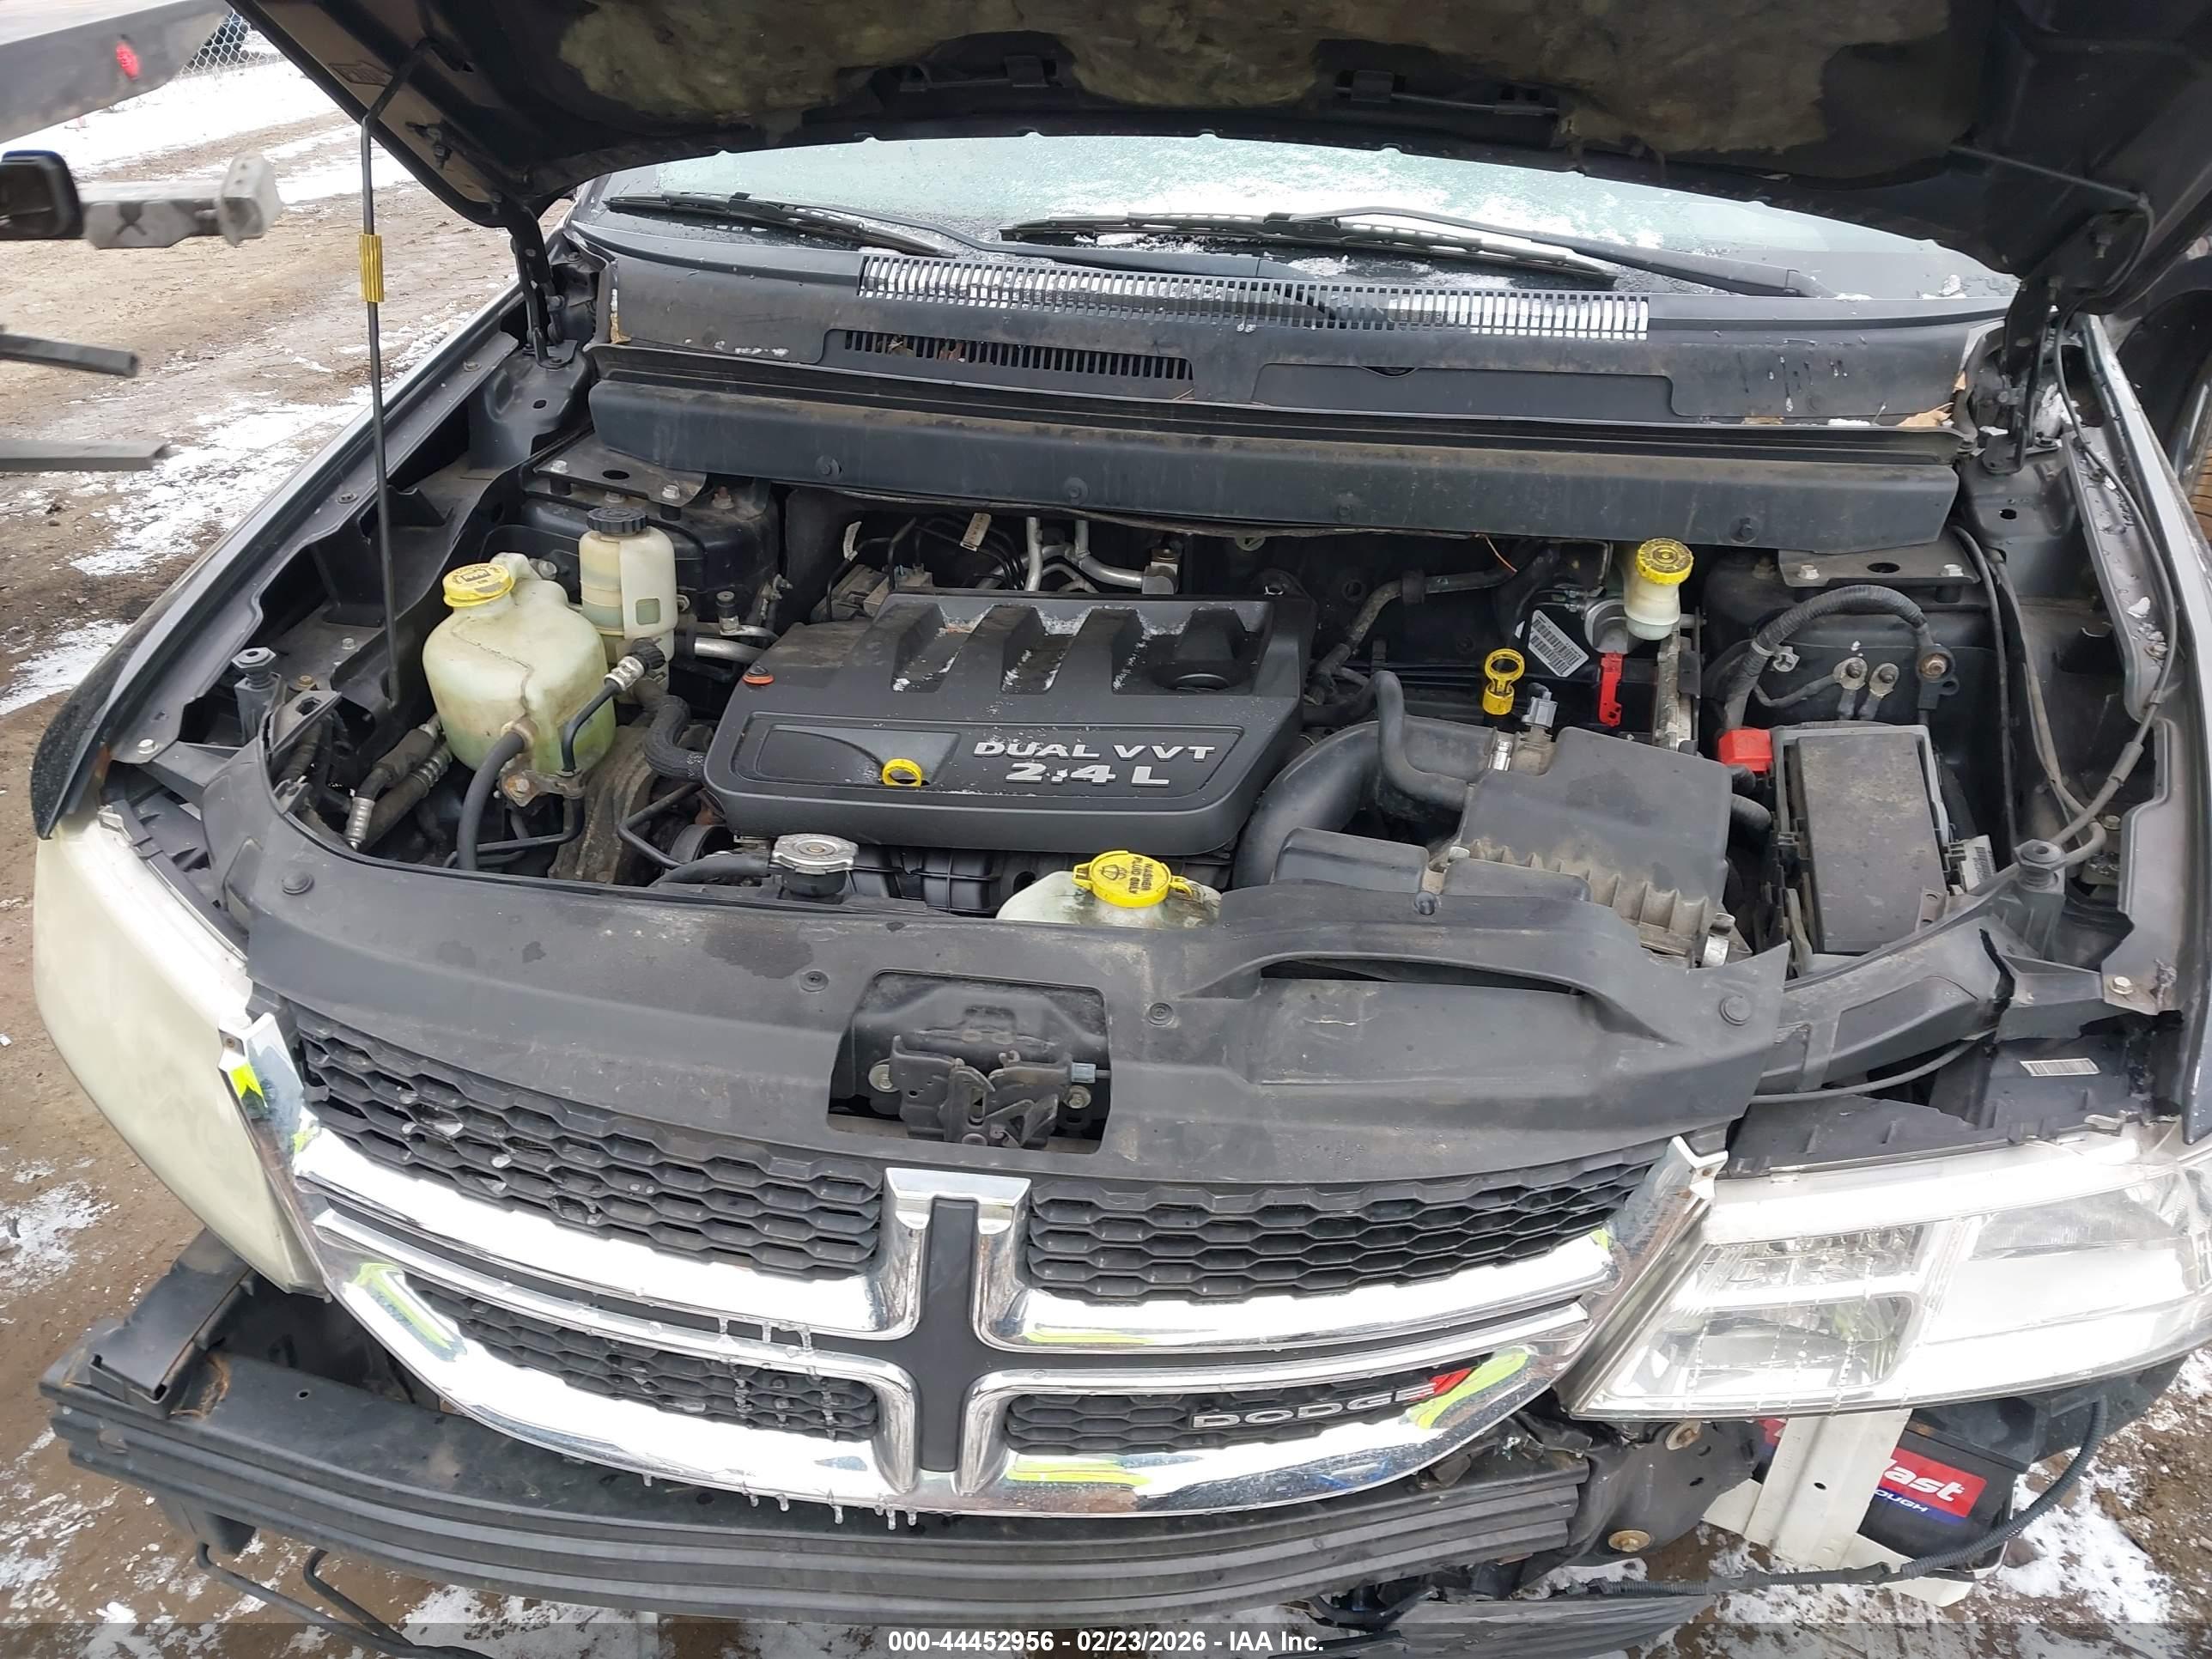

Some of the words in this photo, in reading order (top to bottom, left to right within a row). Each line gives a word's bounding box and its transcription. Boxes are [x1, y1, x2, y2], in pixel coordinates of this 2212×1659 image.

[973, 741, 1100, 760] DUAL
[1113, 744, 1216, 762] VVT
[1005, 762, 1117, 786] 2.4
[1130, 765, 1170, 788] L
[1131, 856, 1142, 875] FLUID
[1141, 863, 1153, 890] WASHER
[1129, 877, 1140, 894] ONLY
[1192, 1382, 1437, 1429] DODGE
